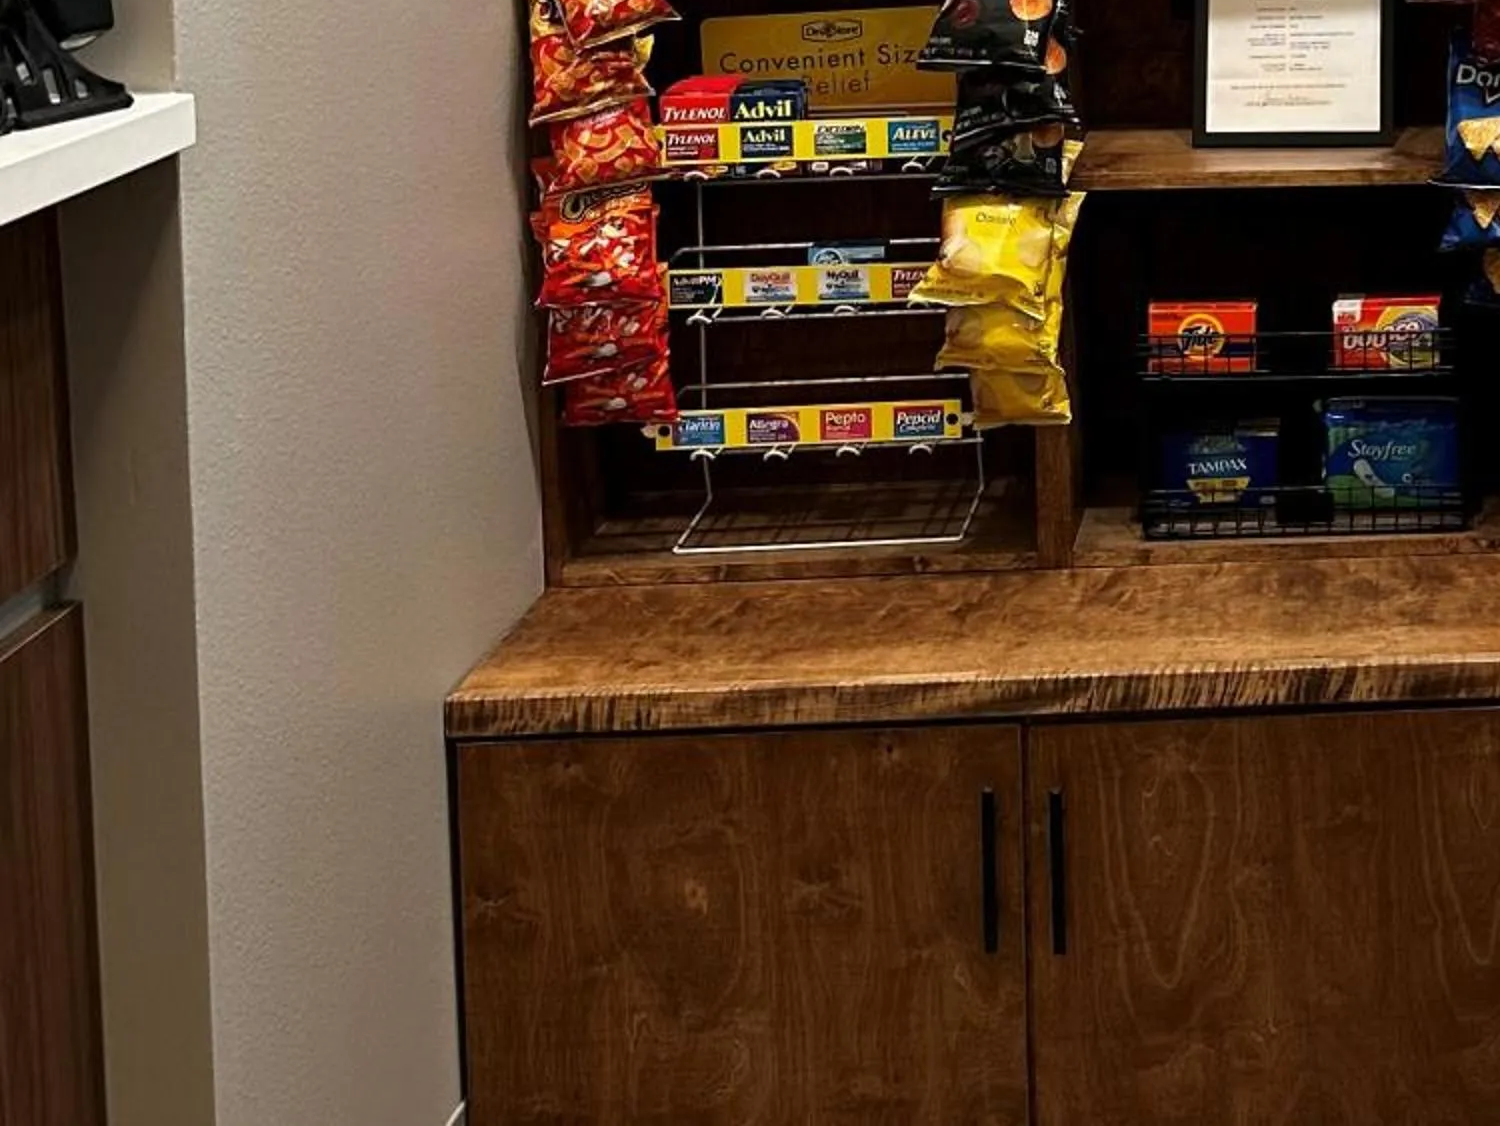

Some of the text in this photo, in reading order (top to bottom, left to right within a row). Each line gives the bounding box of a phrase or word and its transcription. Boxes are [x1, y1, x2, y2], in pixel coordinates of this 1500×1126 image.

[719, 48, 866, 74] Convenient
[664, 106, 727, 122] TYLENOL
[734, 99, 793, 120] Advil
[667, 132, 717, 146] TYLENOL
[743, 127, 786, 143] Advil
[893, 127, 936, 141] ALEVE
[825, 411, 865, 429] Pepto
[896, 410, 941, 427] Pepcid
[1347, 438, 1417, 460] Stayfree
[1187, 458, 1248, 475] TAMPAX
